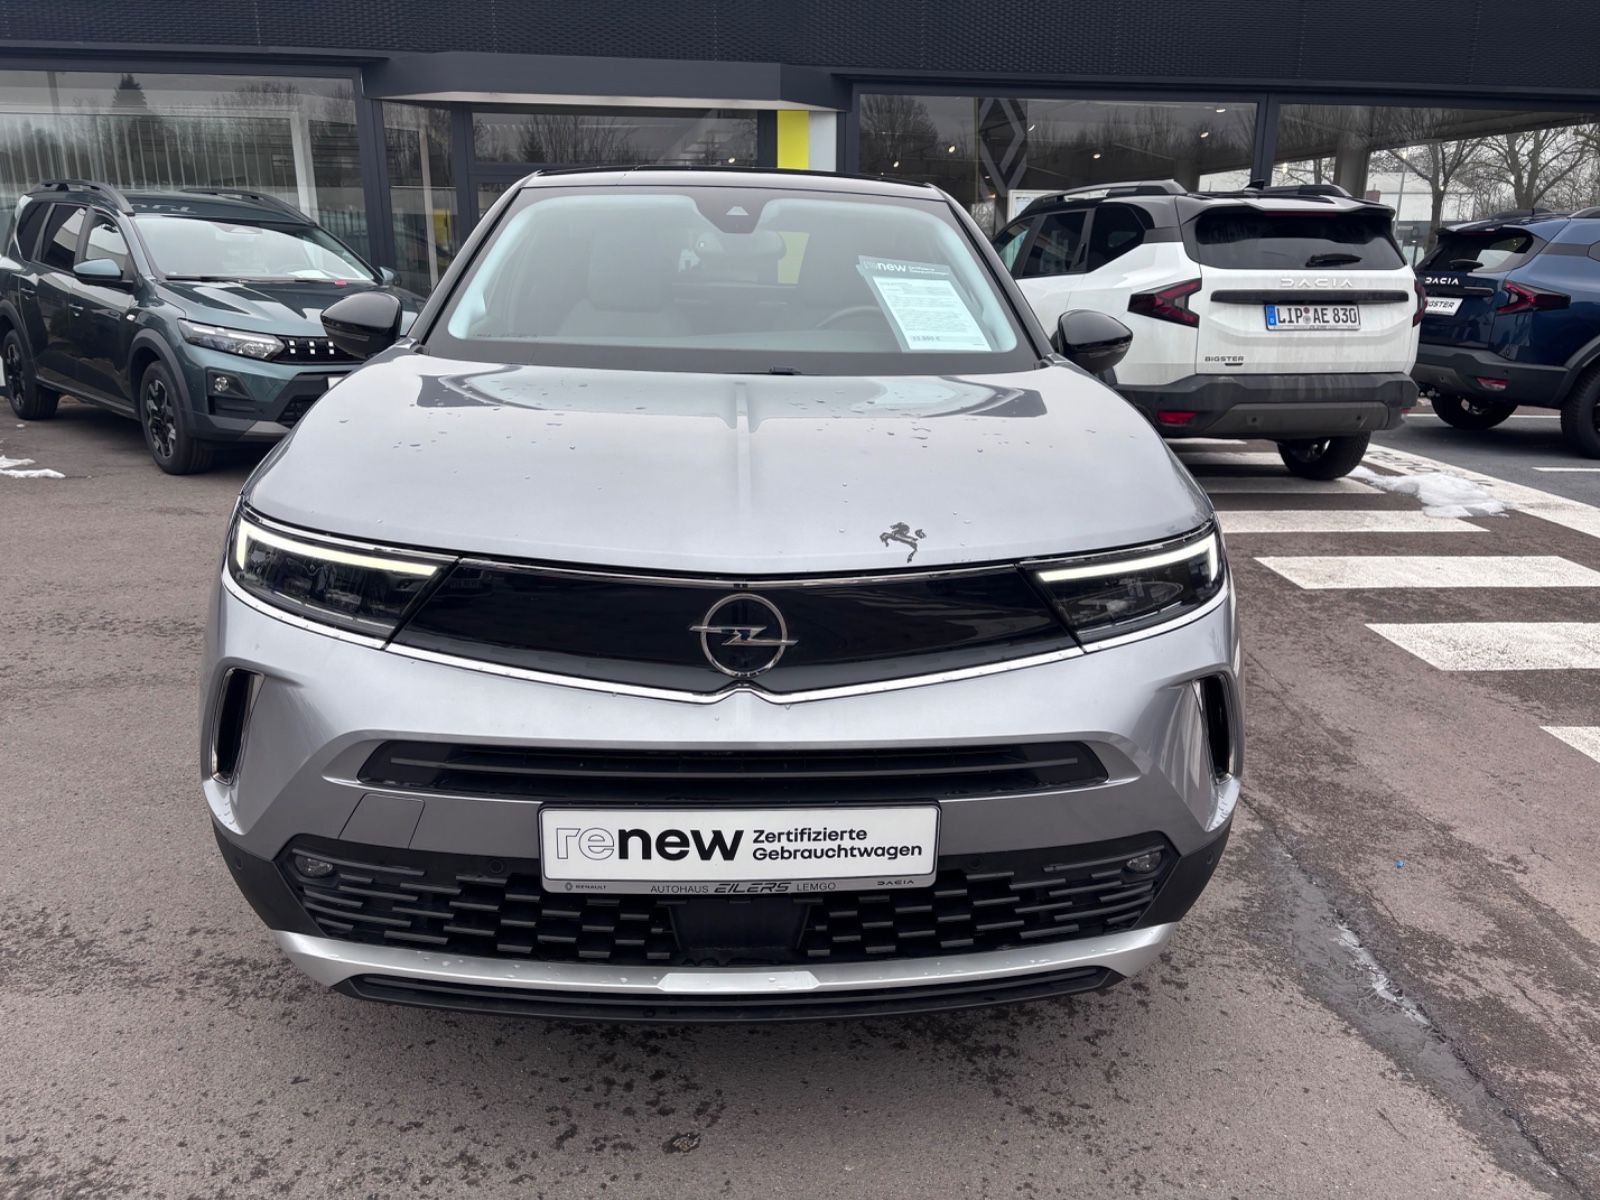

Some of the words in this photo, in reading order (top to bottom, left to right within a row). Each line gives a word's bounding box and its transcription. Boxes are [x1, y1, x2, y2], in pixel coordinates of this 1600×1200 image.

[1280, 278, 1353, 287] DACIA
[1425, 277, 1459, 285] DACIA
[1277, 307, 1303, 323] LIP
[1313, 307, 1330, 323] AE
[1332, 307, 1357, 323] 830
[752, 827, 867, 844] Zertifizierte
[556, 827, 745, 861] renew
[752, 844, 922, 861] Gebrauchtwagen
[650, 884, 709, 894] AUTOHAUS
[714, 882, 792, 894] EILERS
[796, 882, 836, 892] LEMGO
